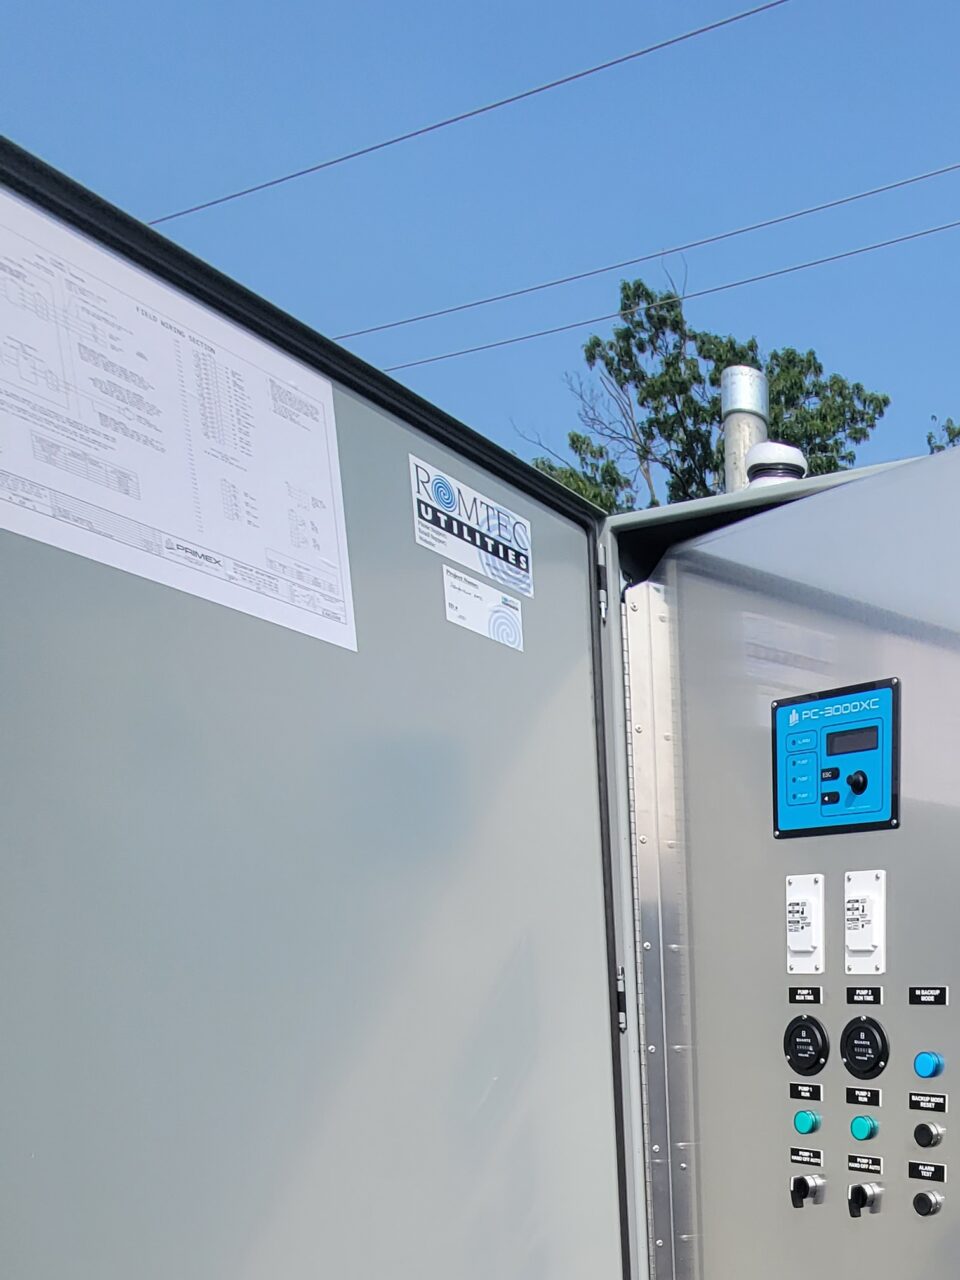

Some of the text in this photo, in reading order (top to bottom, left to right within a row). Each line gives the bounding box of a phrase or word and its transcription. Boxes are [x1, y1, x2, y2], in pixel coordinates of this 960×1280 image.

[413, 462, 529, 552] ROMTEC
[175, 544, 223, 568] PRIMEX
[419, 502, 529, 571] UTILITIES
[802, 698, 880, 720] PC-3000XC
